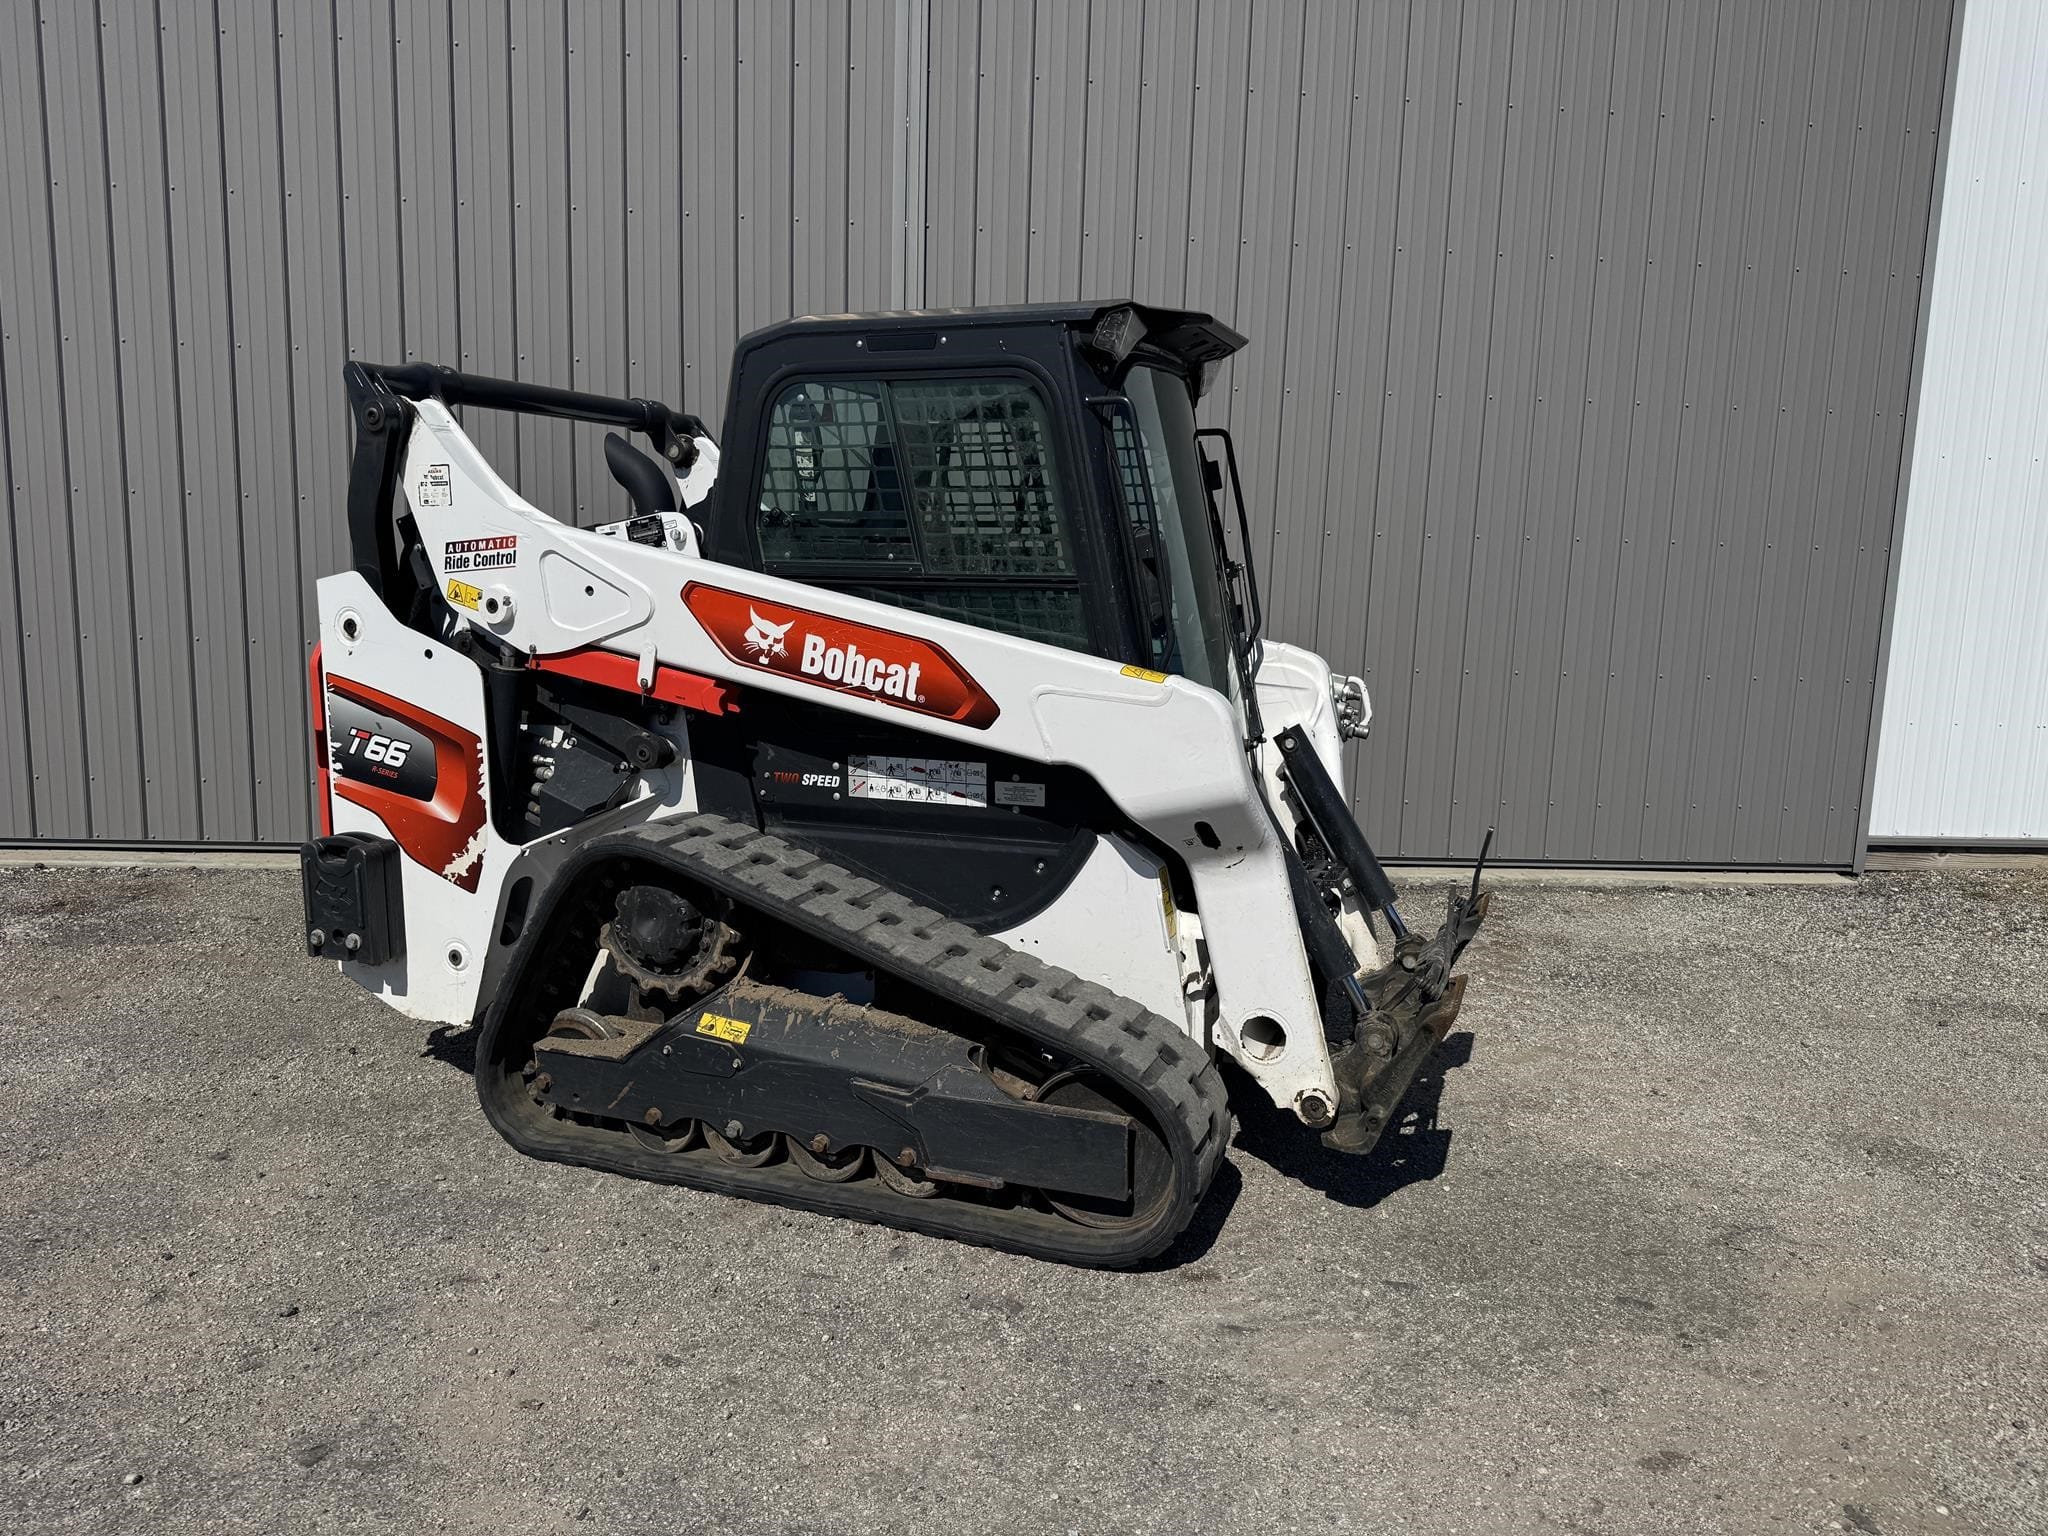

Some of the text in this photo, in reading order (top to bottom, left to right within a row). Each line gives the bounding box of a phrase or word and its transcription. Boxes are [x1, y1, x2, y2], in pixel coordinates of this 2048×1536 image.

[448, 537, 515, 554] AUTOMATIC
[444, 550, 517, 570] Ride Control
[801, 633, 921, 702] Bobcat
[348, 727, 412, 768] T66
[371, 765, 399, 779] R-SERIES
[773, 771, 841, 788] TWO SPEED
